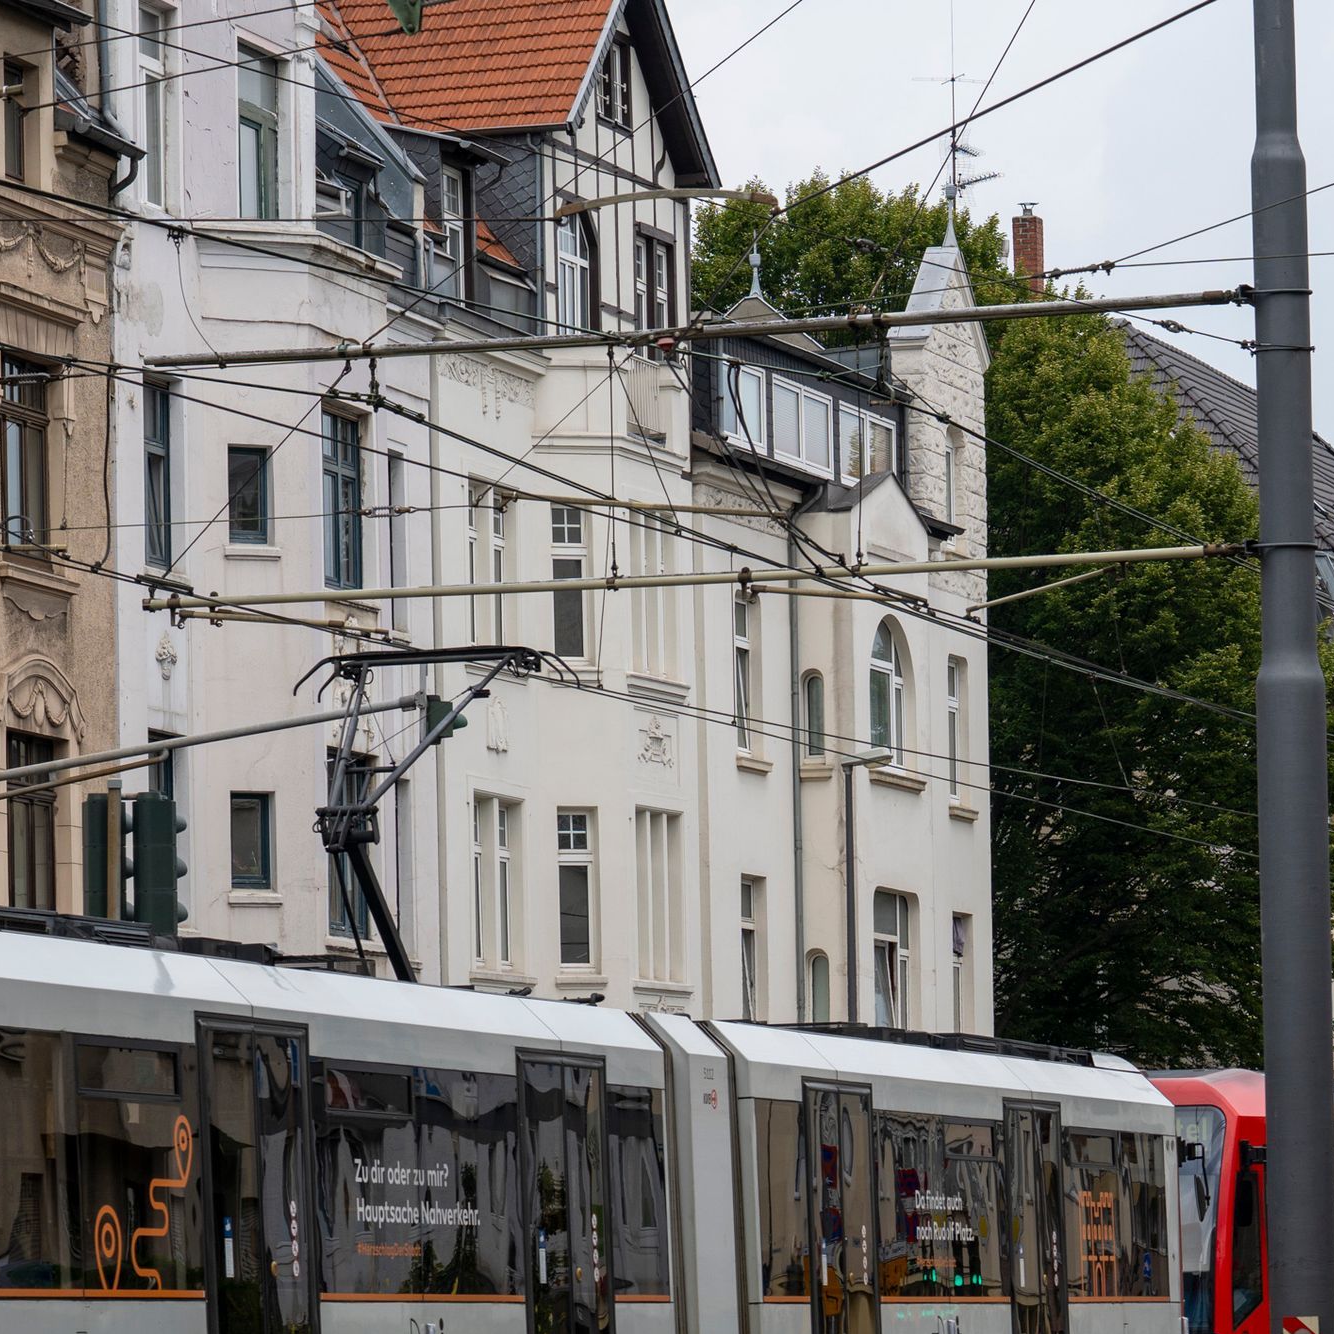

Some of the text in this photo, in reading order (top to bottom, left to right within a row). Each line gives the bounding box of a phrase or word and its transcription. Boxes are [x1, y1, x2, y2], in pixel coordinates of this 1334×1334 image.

[354, 1158, 449, 1187] Zu dir oder zu mir?
[915, 1189, 963, 1211] Da findet auch
[356, 1197, 481, 1229] Hauptsache Nahverkehr.
[916, 1220, 975, 1241] noch Rudolf Platz.
